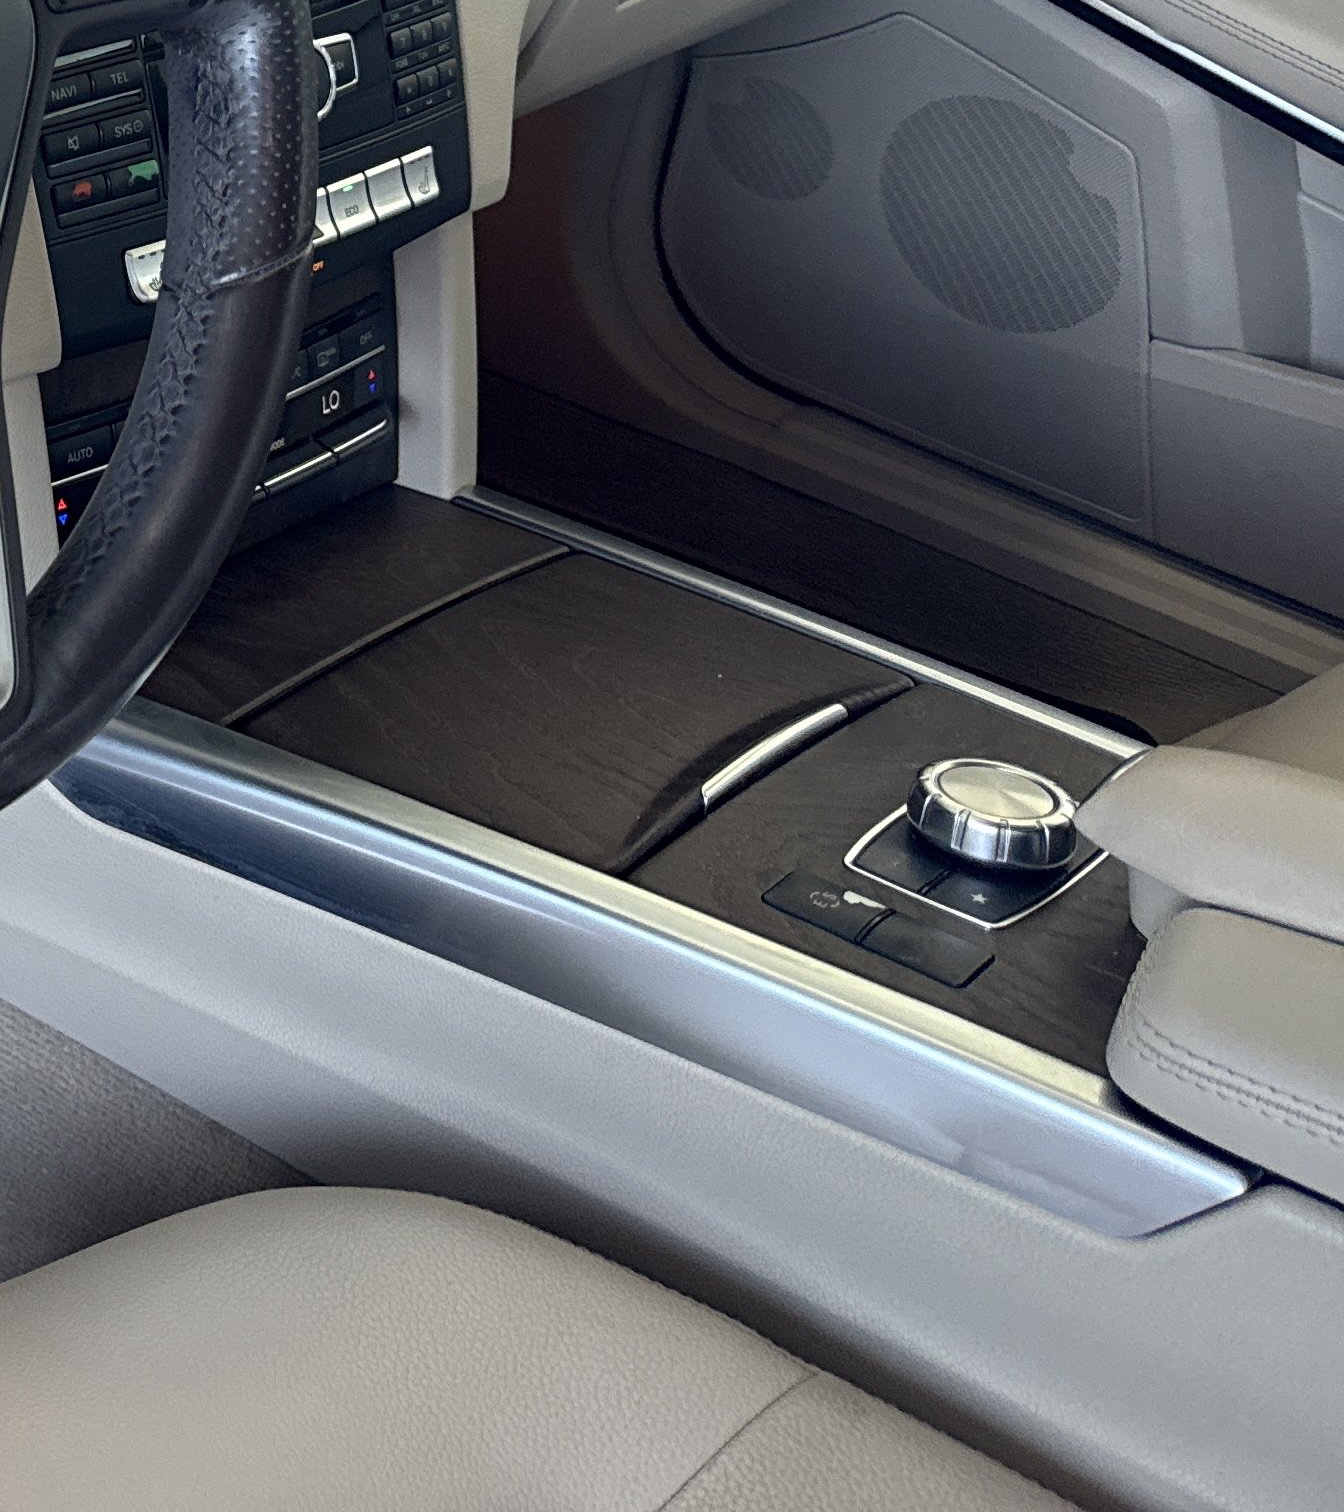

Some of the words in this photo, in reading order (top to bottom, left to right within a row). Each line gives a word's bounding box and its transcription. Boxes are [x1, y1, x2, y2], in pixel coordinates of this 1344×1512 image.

[110, 71, 130, 85] TEL
[51, 85, 77, 101] NAVI
[114, 123, 133, 138] SYS
[344, 204, 360, 218] ECO
[321, 389, 340, 415] LO
[67, 446, 94, 464] AUTO
